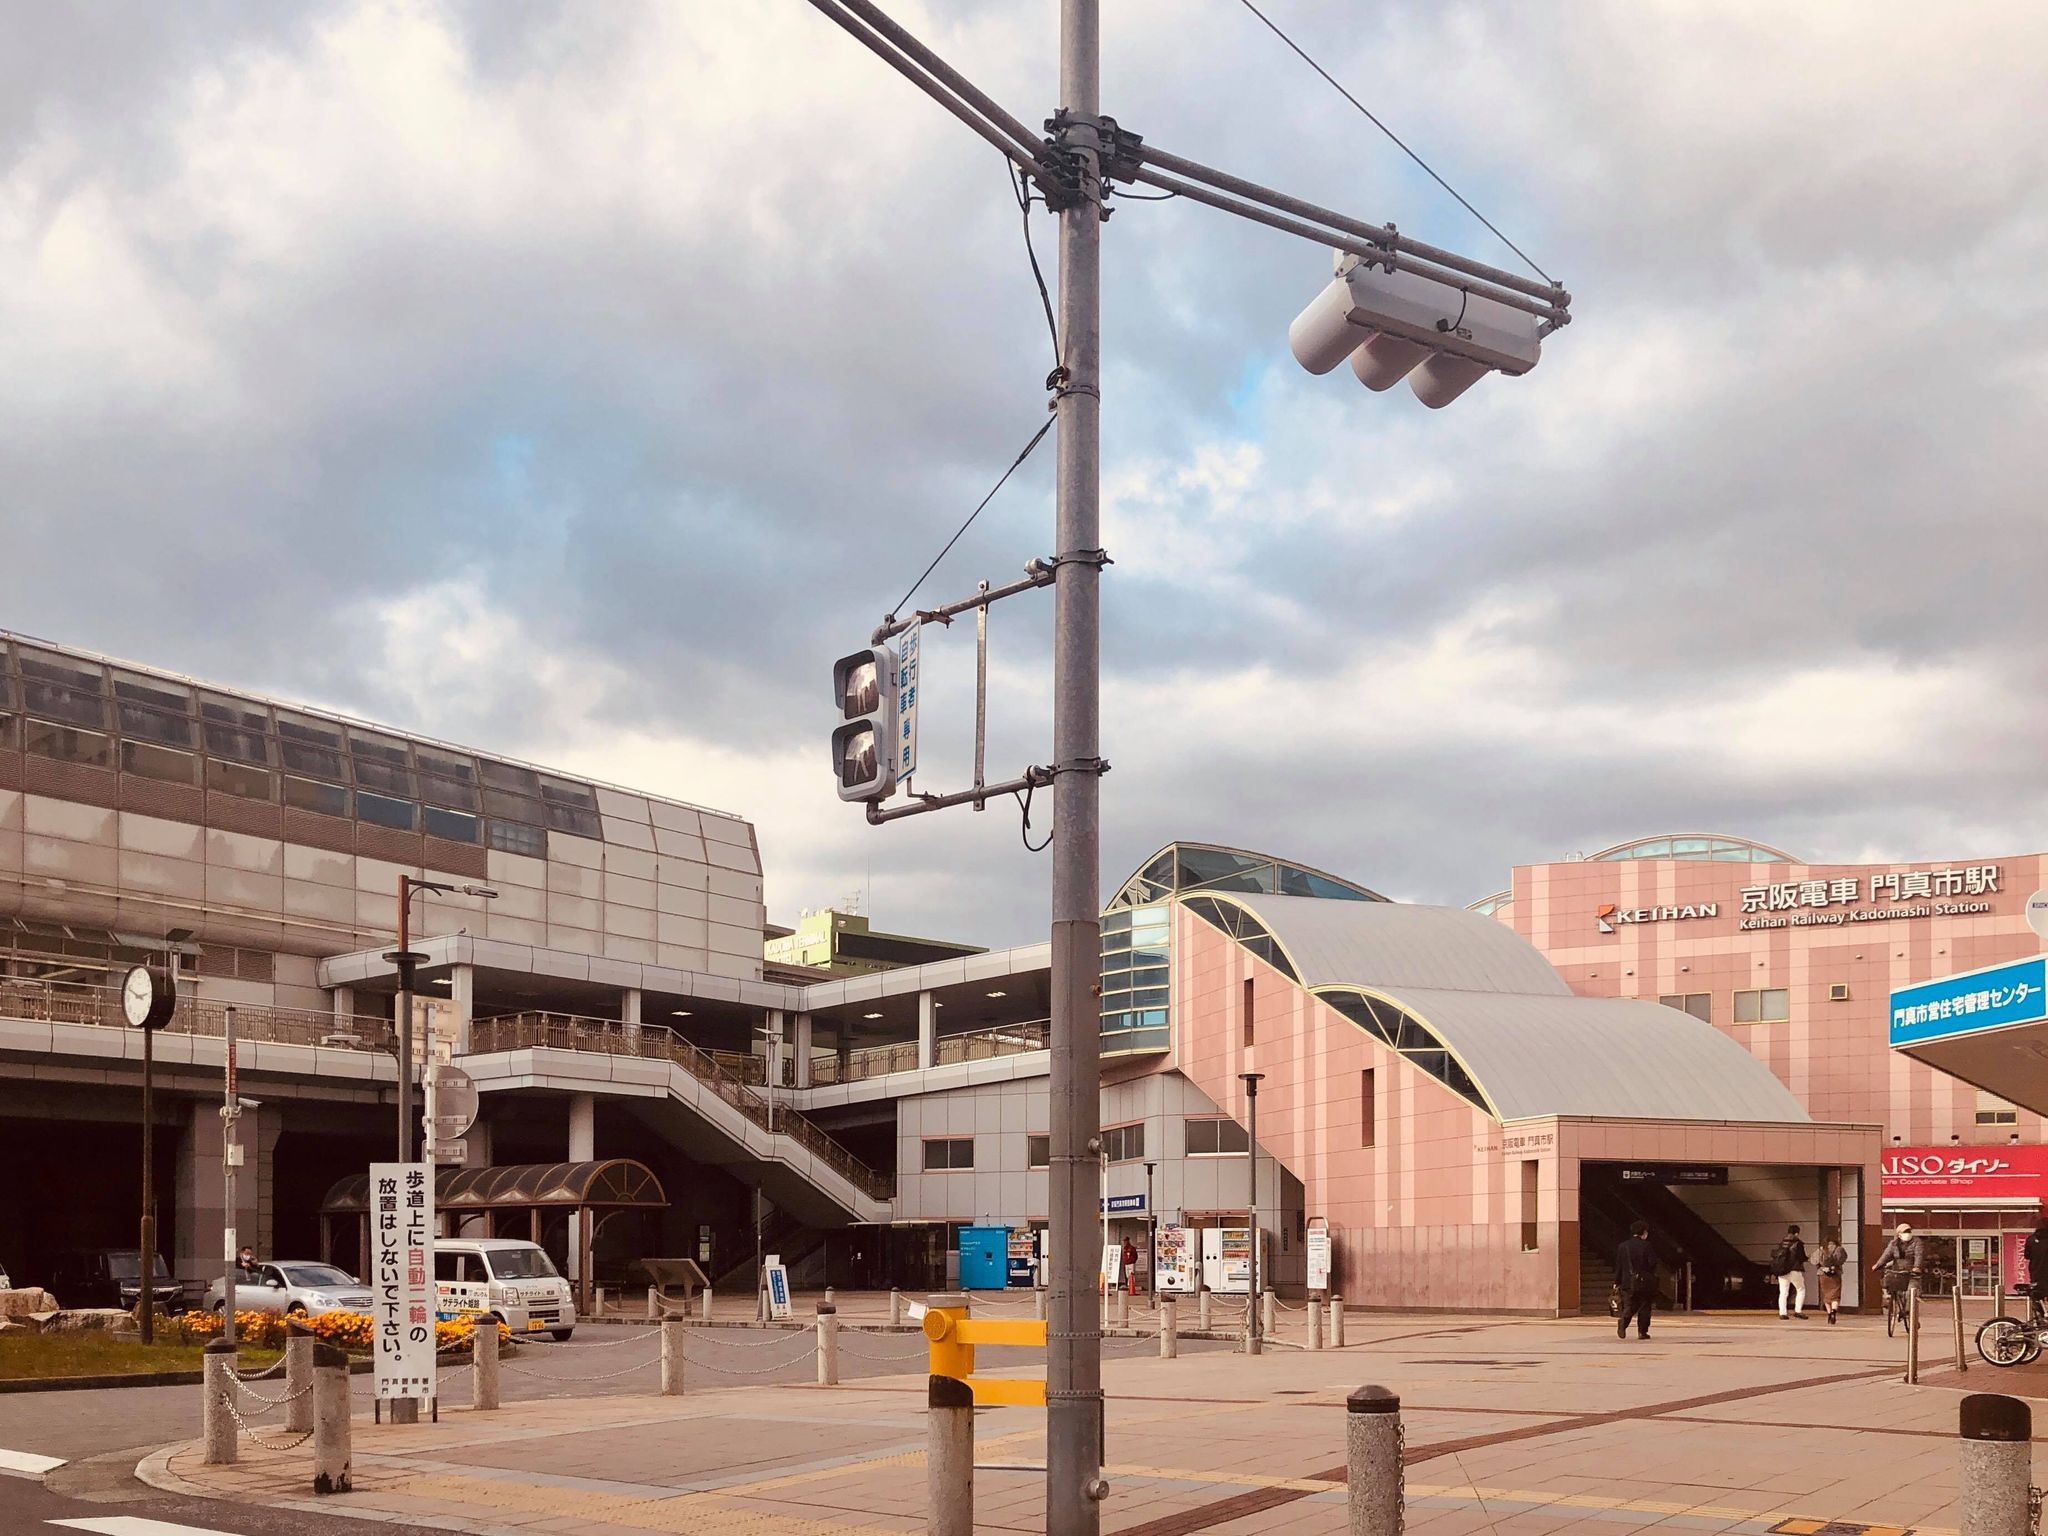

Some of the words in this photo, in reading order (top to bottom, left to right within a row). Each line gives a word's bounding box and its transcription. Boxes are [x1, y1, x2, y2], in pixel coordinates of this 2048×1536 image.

[1739, 877, 1859, 914] 京阪電車
[1870, 865, 1999, 904] 門真市駅
[1616, 903, 1718, 924] KEIHAN
[1739, 916, 1786, 931] Keihan
[1791, 912, 1848, 929] Railway
[1849, 904, 1931, 923] Kadomashi
[1935, 899, 1990, 916] Station
[1893, 982, 2042, 1029] 門真市営住宅管理センター
[1900, 1178, 1948, 1186] Coordinate
[1950, 1177, 1974, 1186] Shop
[1947, 1157, 2010, 1175] ダイソー
[378, 1178, 402, 1362] 放置はしないで下さい。
[405, 1170, 428, 1344] 歩道上に自動二輪の
